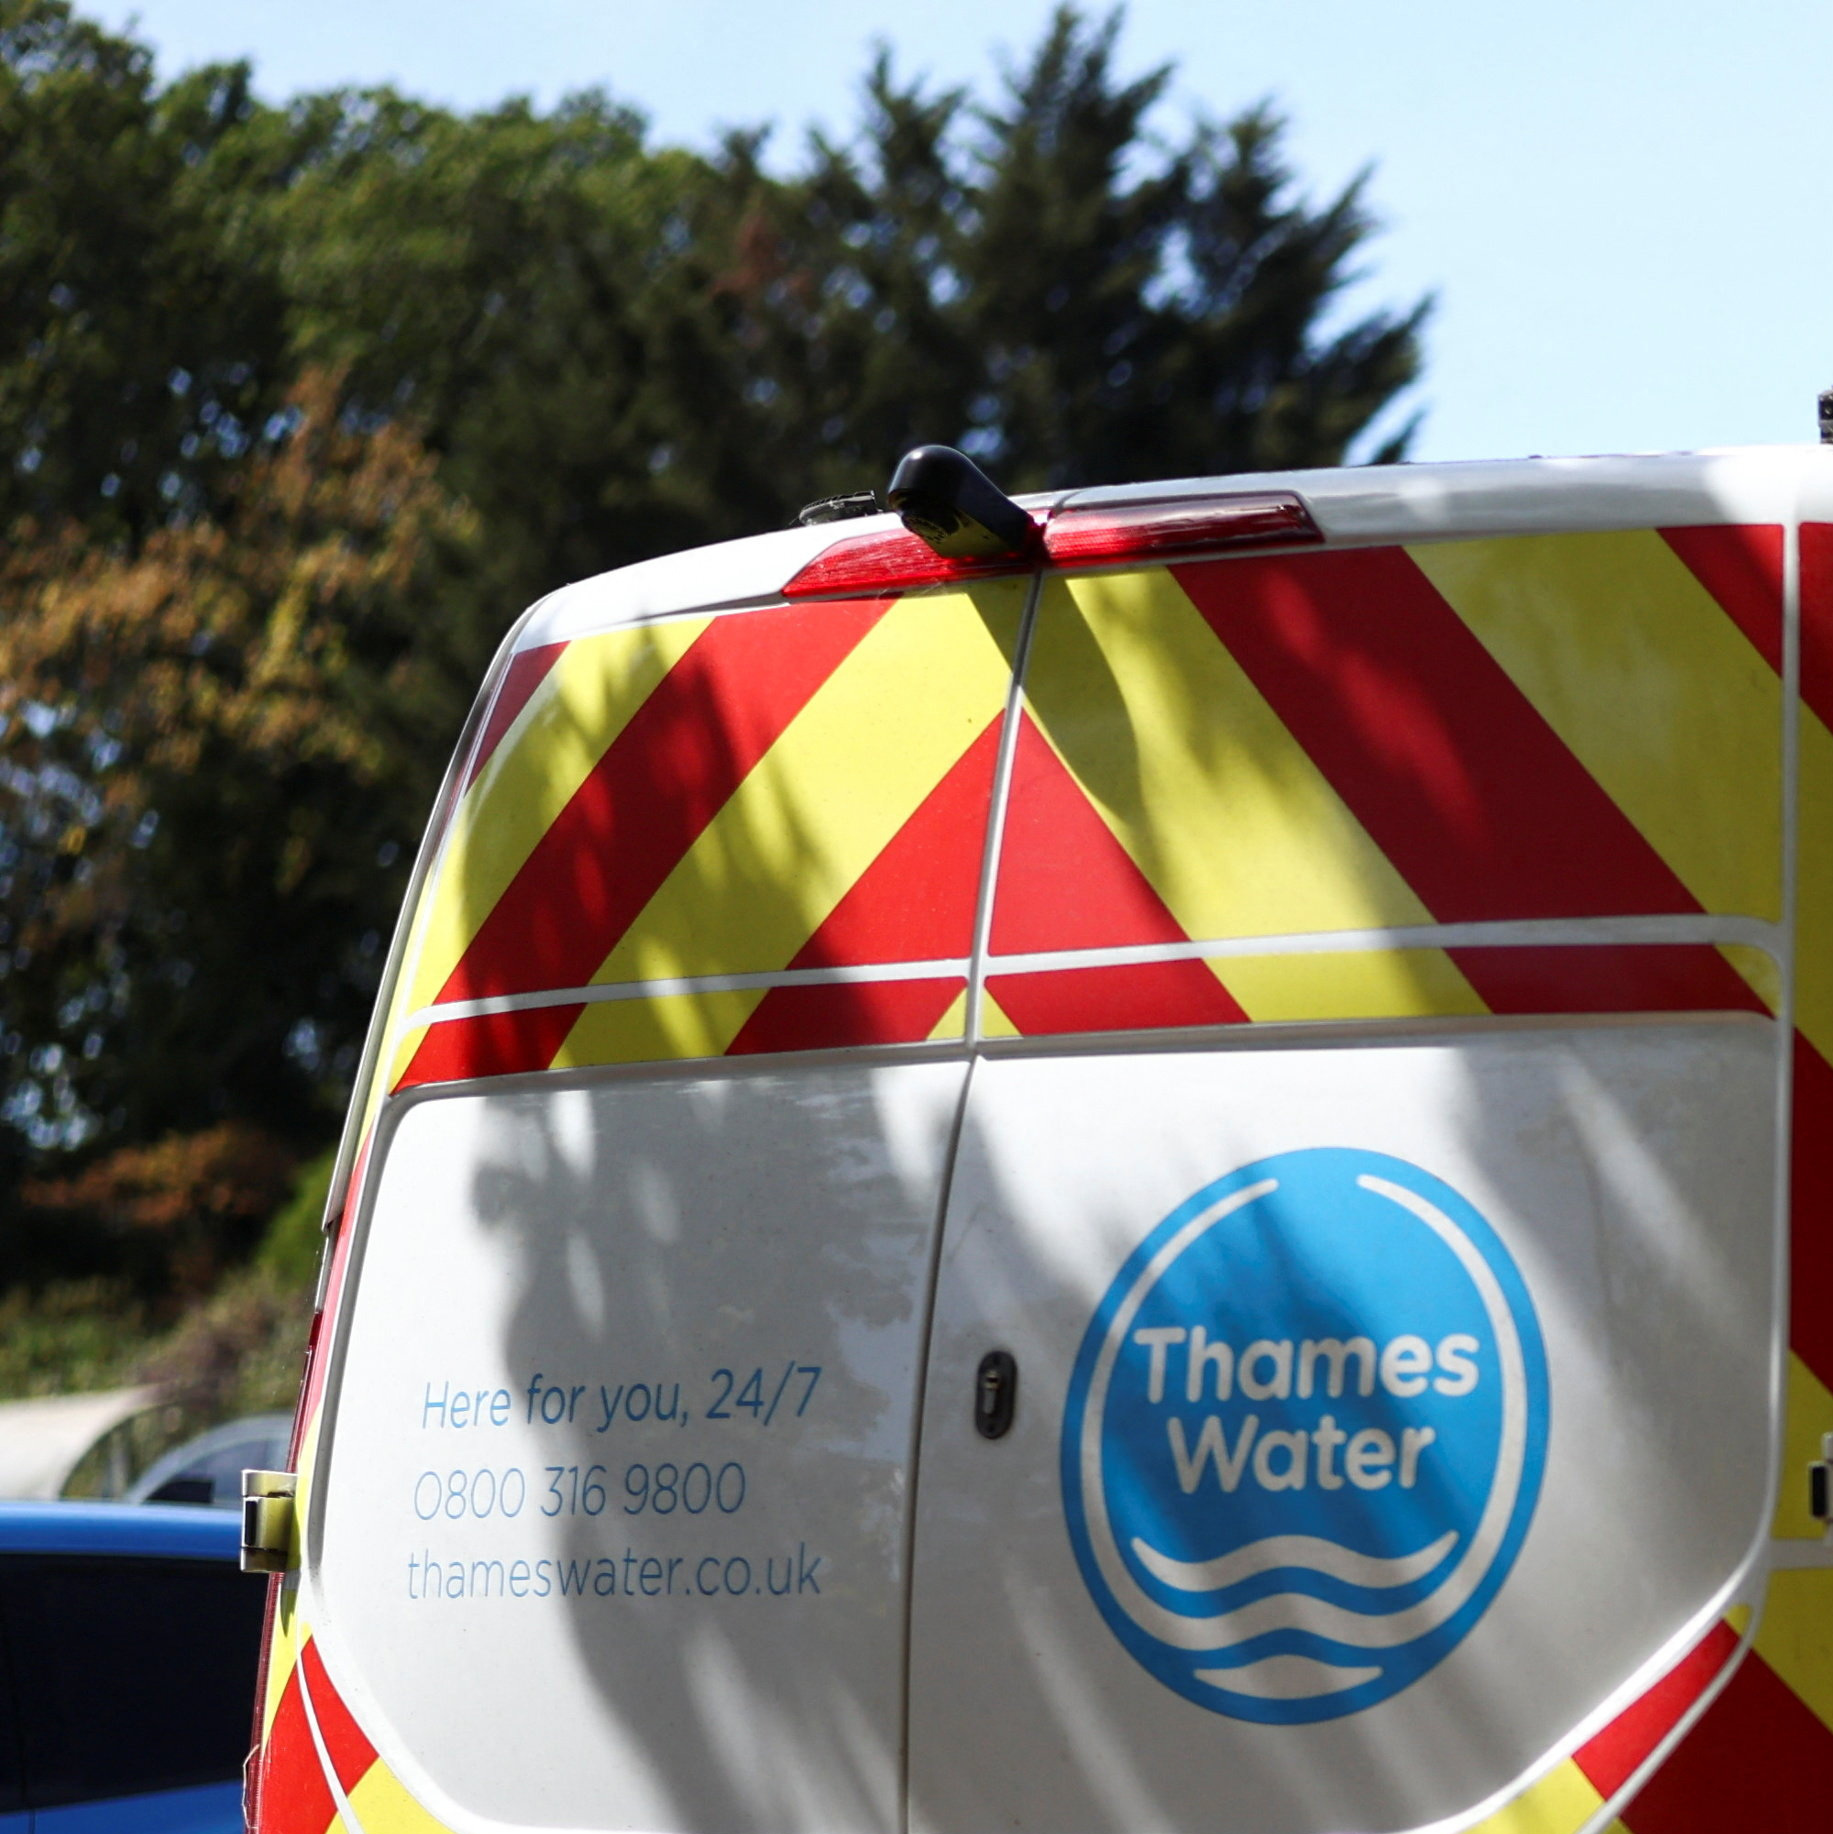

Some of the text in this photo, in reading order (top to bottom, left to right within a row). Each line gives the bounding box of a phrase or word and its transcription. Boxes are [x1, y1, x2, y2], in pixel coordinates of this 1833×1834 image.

[422, 1361, 823, 1433] Here for you, 24/7
[1133, 1325, 1480, 1404] Thames
[1167, 1414, 1435, 1494] Water
[414, 1461, 746, 1520] 0800 316 9800
[407, 1541, 823, 1599] thameswater.co.uk
